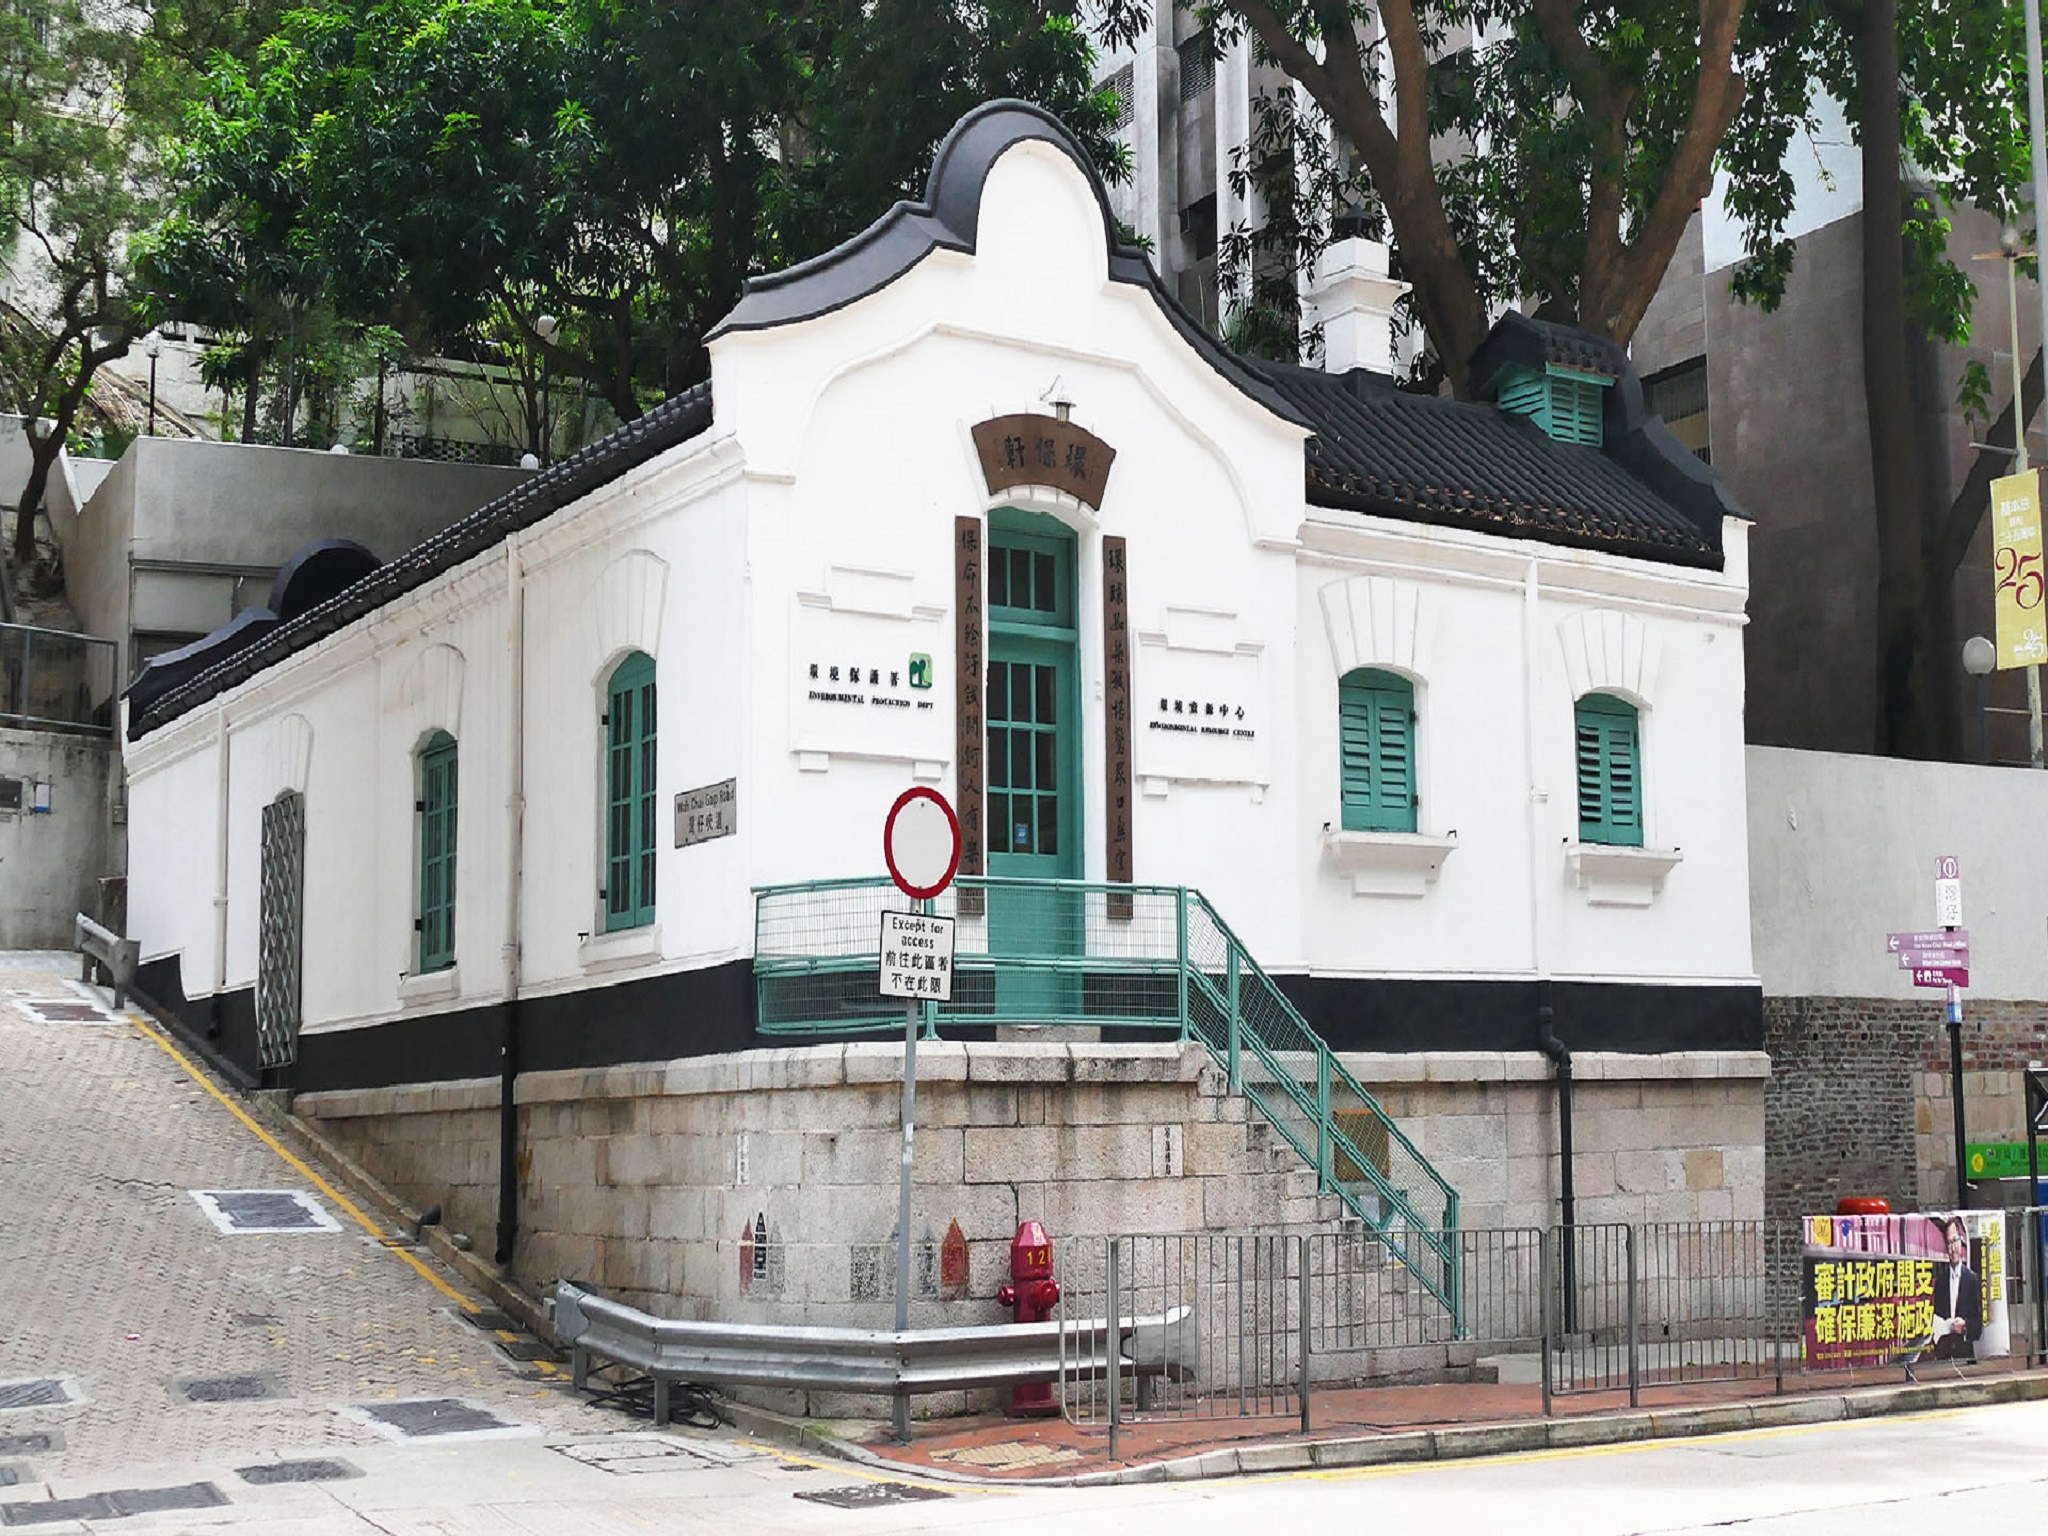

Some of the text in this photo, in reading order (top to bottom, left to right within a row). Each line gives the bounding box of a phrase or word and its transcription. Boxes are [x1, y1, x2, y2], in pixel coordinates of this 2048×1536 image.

[1995, 547, 2045, 610] 25
[892, 916, 944, 935] Except for
[901, 935, 935, 950] access
[885, 950, 949, 972] 前往此區者
[891, 972, 942, 994] 不在此限
[1814, 1259, 1934, 1302] 審計政府開支
[1814, 1299, 1935, 1344] 確保廉潔施政
